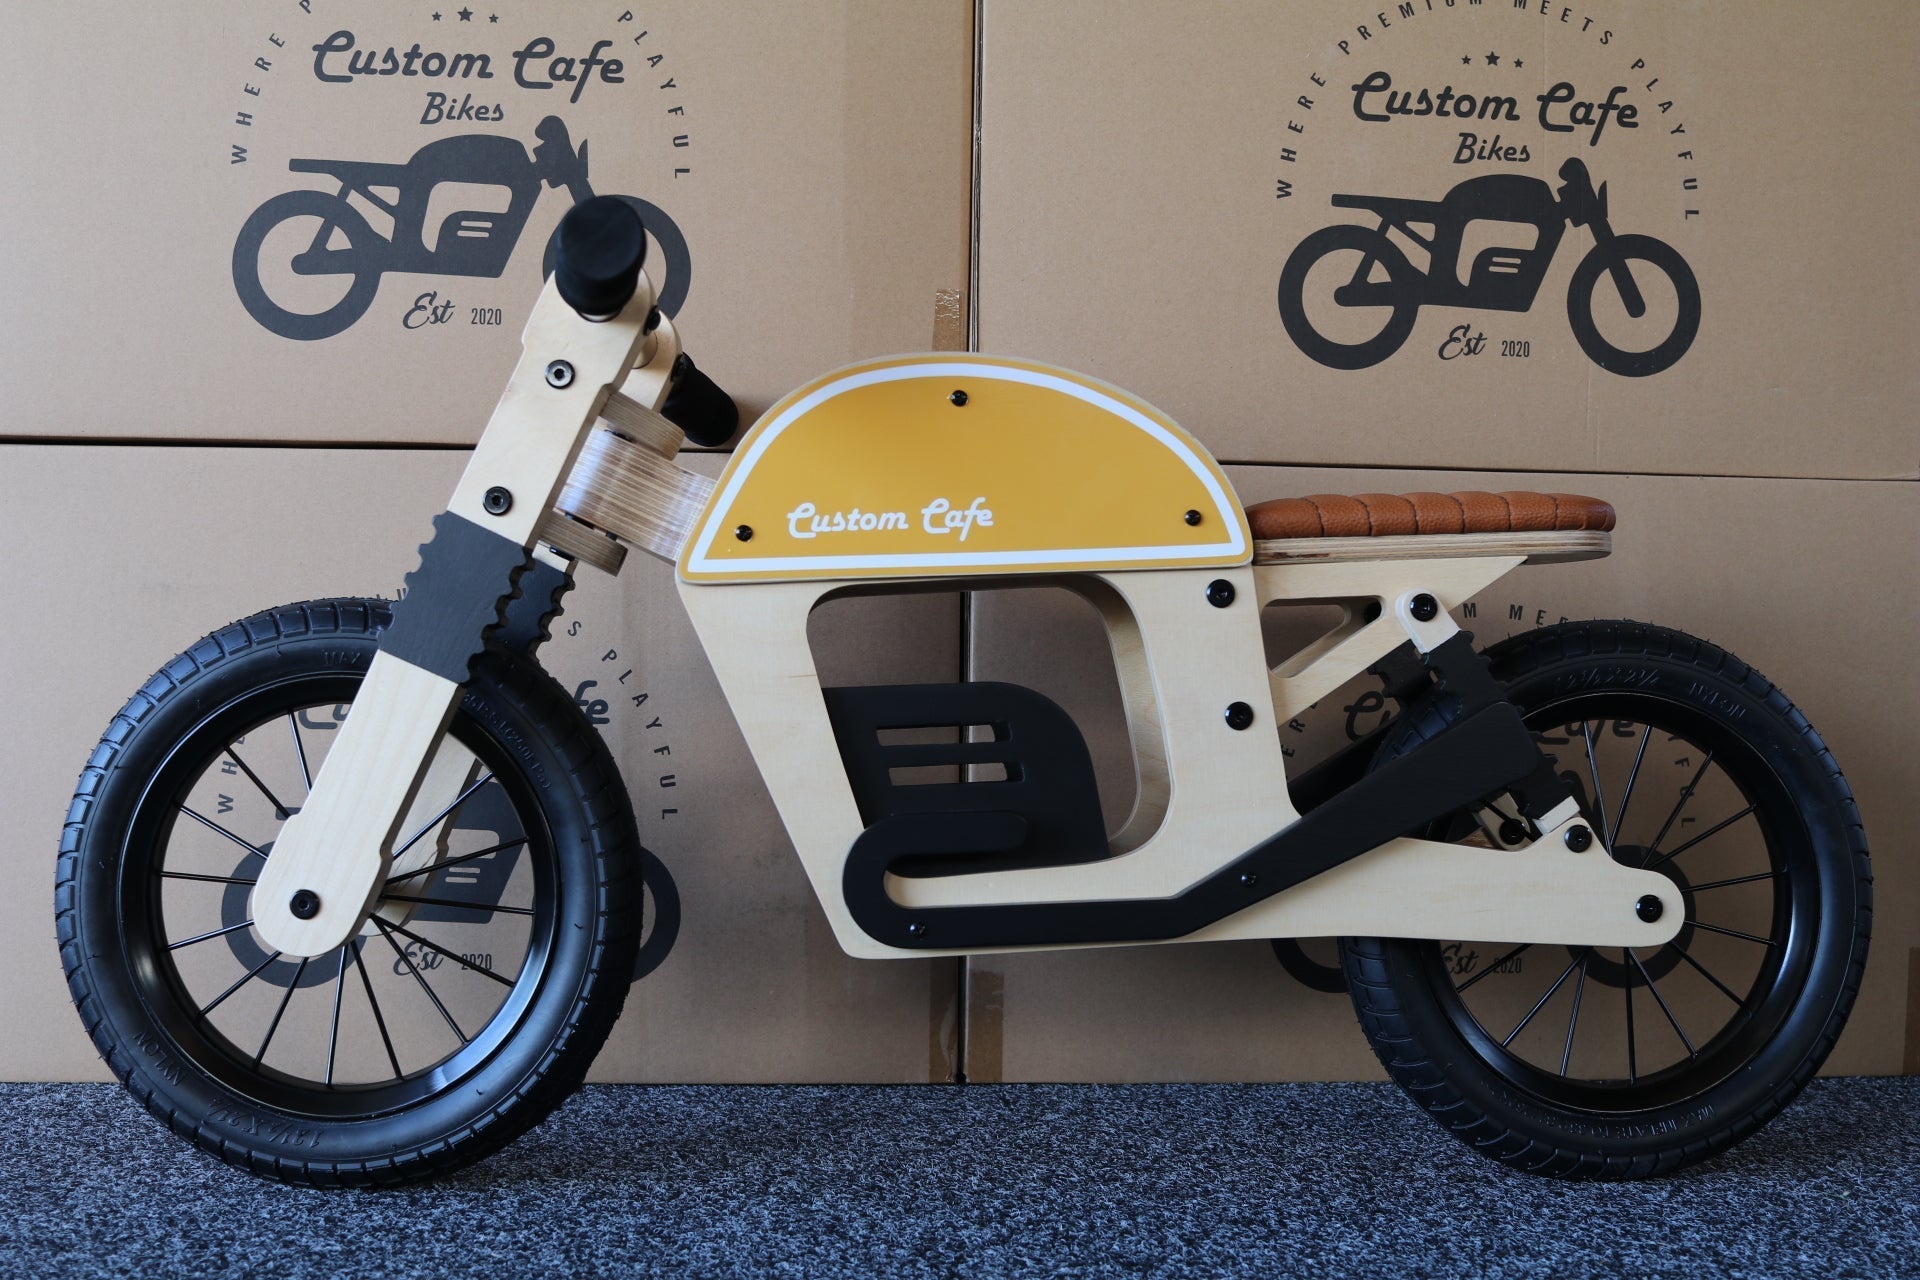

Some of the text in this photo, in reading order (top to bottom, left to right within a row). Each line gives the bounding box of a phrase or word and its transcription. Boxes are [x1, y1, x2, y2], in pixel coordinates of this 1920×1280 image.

[312, 30, 625, 103] Custom Cafe
[617, 10, 691, 179] PLAYFUL
[231, 33, 286, 165] WHERE
[419, 92, 504, 125] Bikes
[1276, 72, 1326, 199] WHERE
[1513, 0, 1613, 45] MEETS
[1630, 58, 1700, 220] PLAYFUL
[1352, 71, 1639, 147] Custom Cafe
[1453, 132, 1530, 164] Bikes
[402, 291, 502, 329] Est 2020
[1438, 324, 1530, 360] Est 2020
[787, 497, 994, 541] Custom Cafe
[602, 649, 678, 820] PLAYFUL
[393, 938, 492, 976] Est 2020
